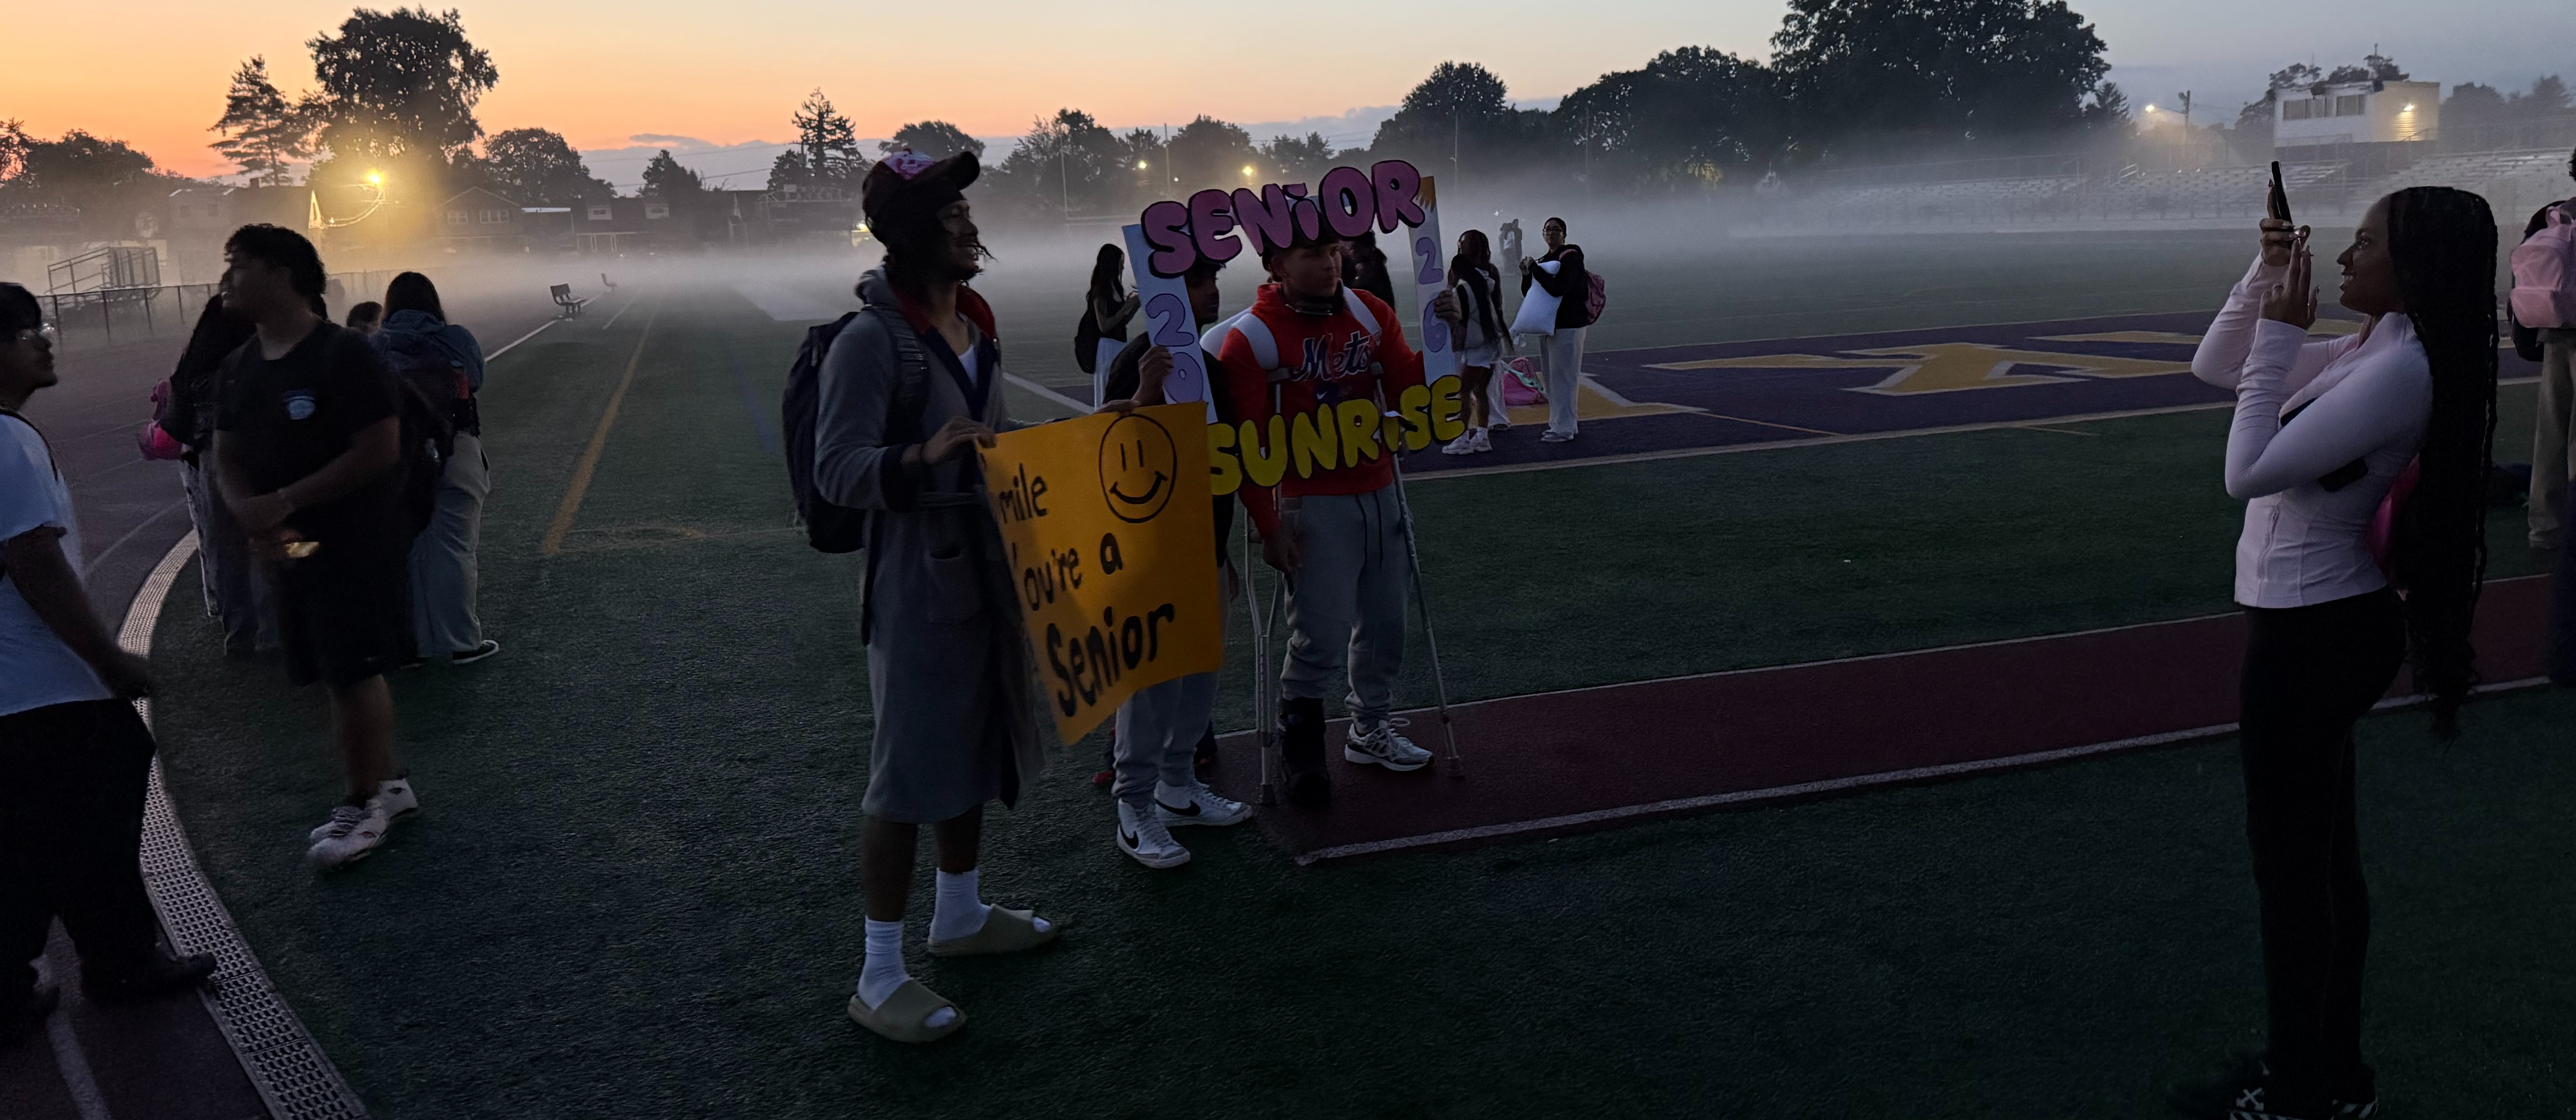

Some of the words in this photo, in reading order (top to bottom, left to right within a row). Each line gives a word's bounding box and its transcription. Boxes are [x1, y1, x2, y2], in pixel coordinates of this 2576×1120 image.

[1290, 330, 1371, 382] Mets
[980, 452, 1047, 524] mile
[1012, 542, 1082, 611] ou're
[1099, 532, 1123, 575] a
[1046, 603, 1176, 717] Senior
